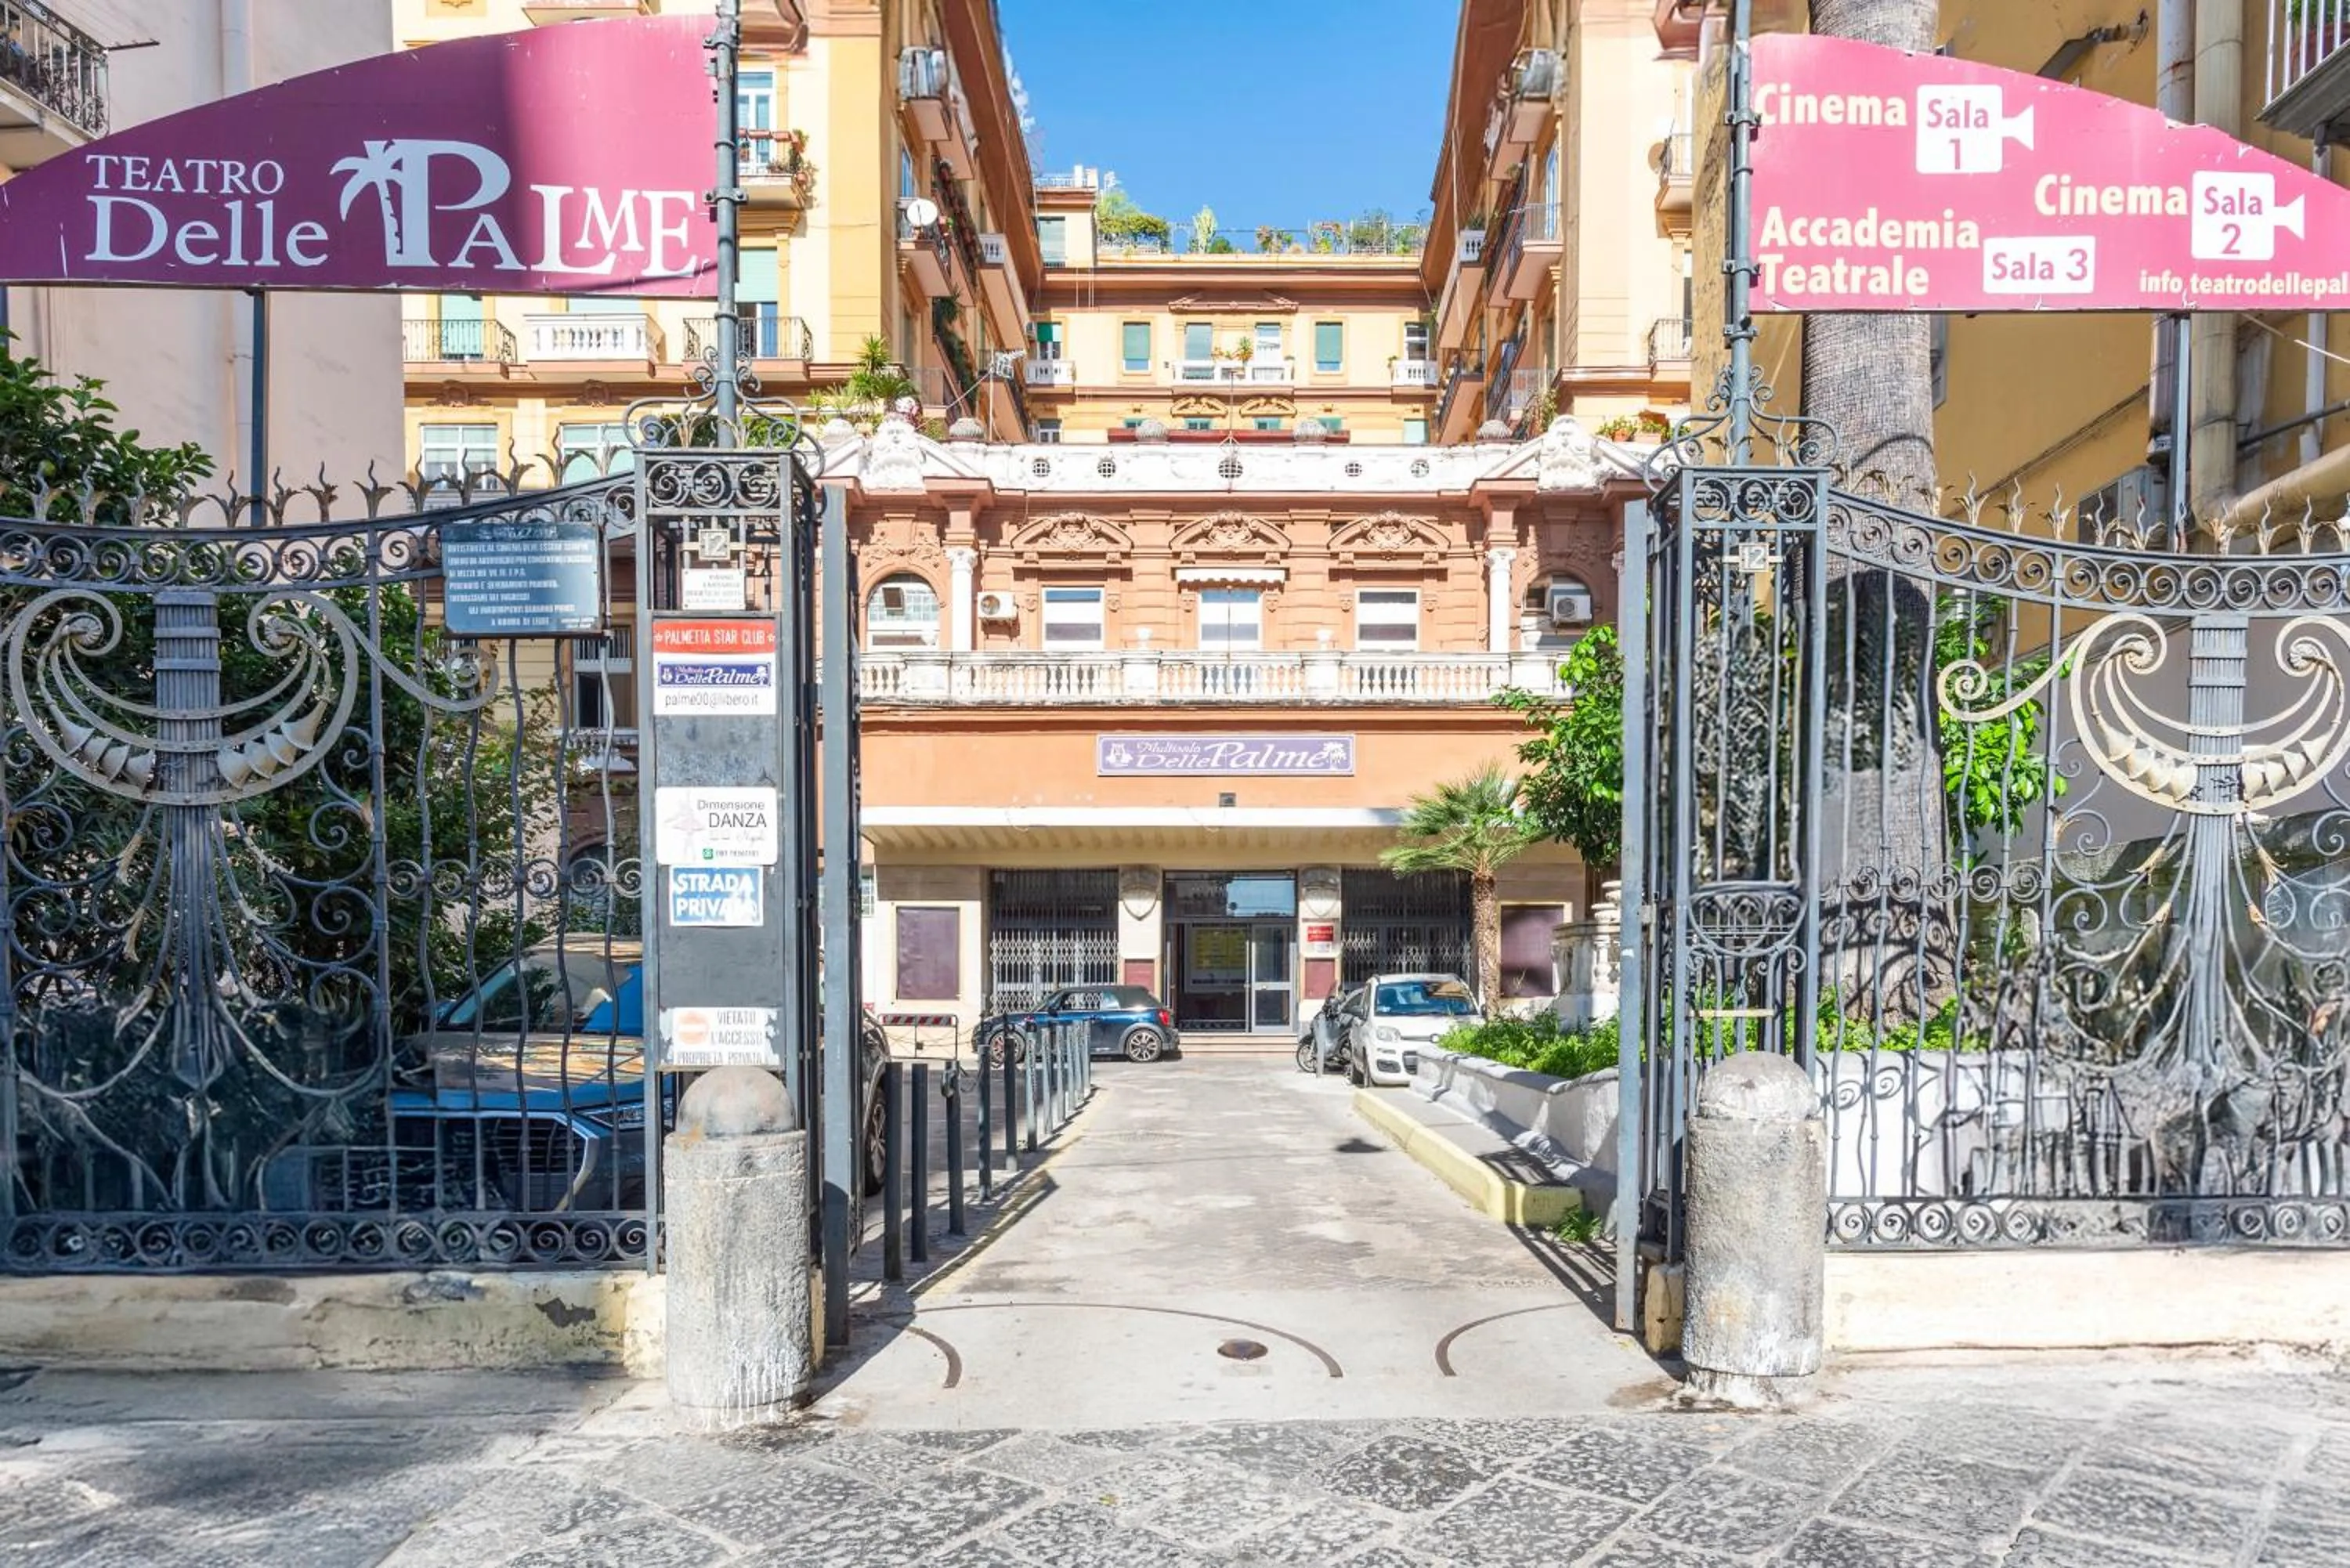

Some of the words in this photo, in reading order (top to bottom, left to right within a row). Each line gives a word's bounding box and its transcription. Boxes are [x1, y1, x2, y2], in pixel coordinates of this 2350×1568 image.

[1754, 82, 1907, 126] Cinema
[1926, 99, 1990, 129] Sala
[1949, 139, 1961, 169] 1
[86, 155, 284, 194] TEATRO
[85, 195, 328, 267] Delle
[363, 139, 699, 276] PALME
[2034, 174, 2188, 215] Cinema
[2204, 186, 2263, 215] Sala
[1759, 206, 1979, 249] Accademia
[2221, 223, 2241, 255] 2
[1758, 253, 1929, 295] Teatrale
[1992, 252, 2055, 280] Sala
[2066, 248, 2088, 281] 3
[2140, 269, 2183, 293] info
[703, 533, 726, 555] 12
[1744, 547, 1765, 569] 12
[665, 630, 710, 644] PALMETTA
[714, 630, 738, 644] STAR
[742, 630, 765, 644] CLUB
[705, 667, 759, 685] Palme
[1136, 754, 1210, 768] Delle
[1204, 742, 1329, 769] Palme
[697, 800, 765, 811] Dimensione
[709, 813, 767, 828] DANZA
[677, 874, 754, 892] STRADA
[676, 898, 758, 918] PRIVA
[717, 1010, 756, 1025] VIETATO
[710, 1031, 762, 1045] L'ACCESSO
